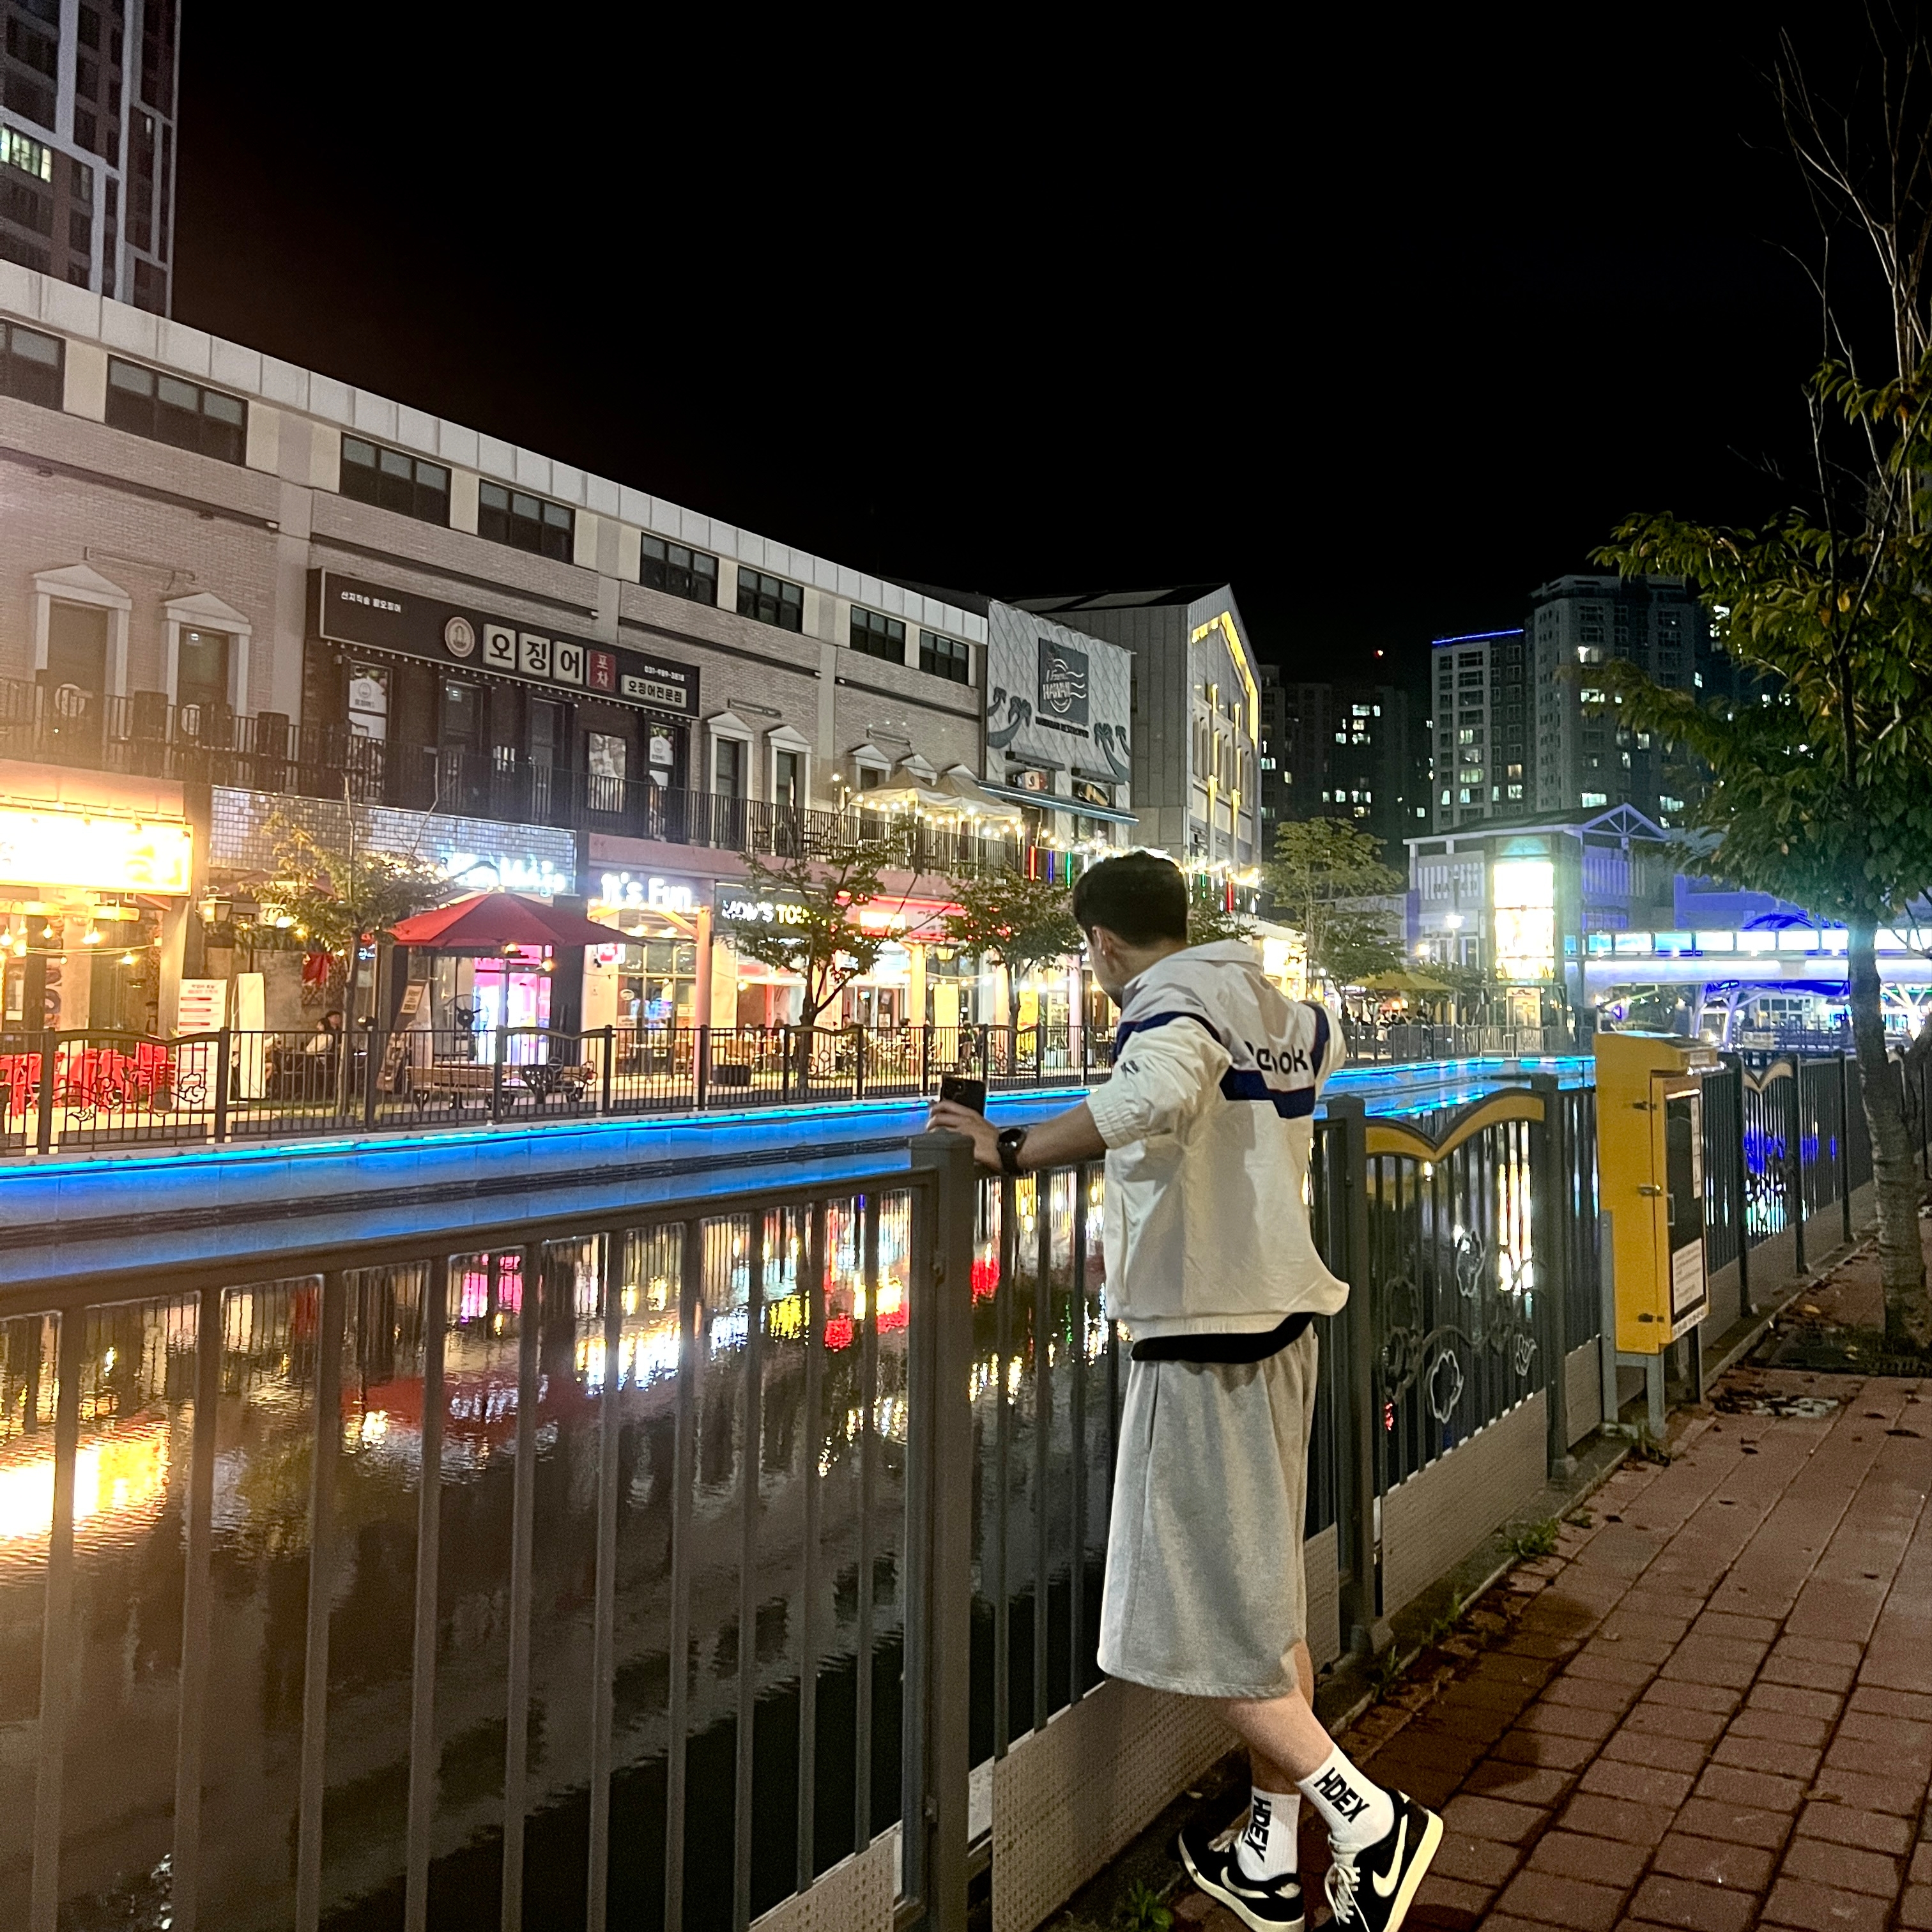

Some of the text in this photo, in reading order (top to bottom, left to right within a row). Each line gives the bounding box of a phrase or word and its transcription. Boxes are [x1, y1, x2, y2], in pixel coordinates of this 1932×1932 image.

[489, 633, 579, 679] 오징어
[596, 654, 609, 687] 포차
[628, 680, 682, 703] 오징어전문점
[648, 877, 691, 914] Fun
[1314, 1767, 1370, 1823] HDEX
[1244, 1795, 1272, 1864] HDEX
